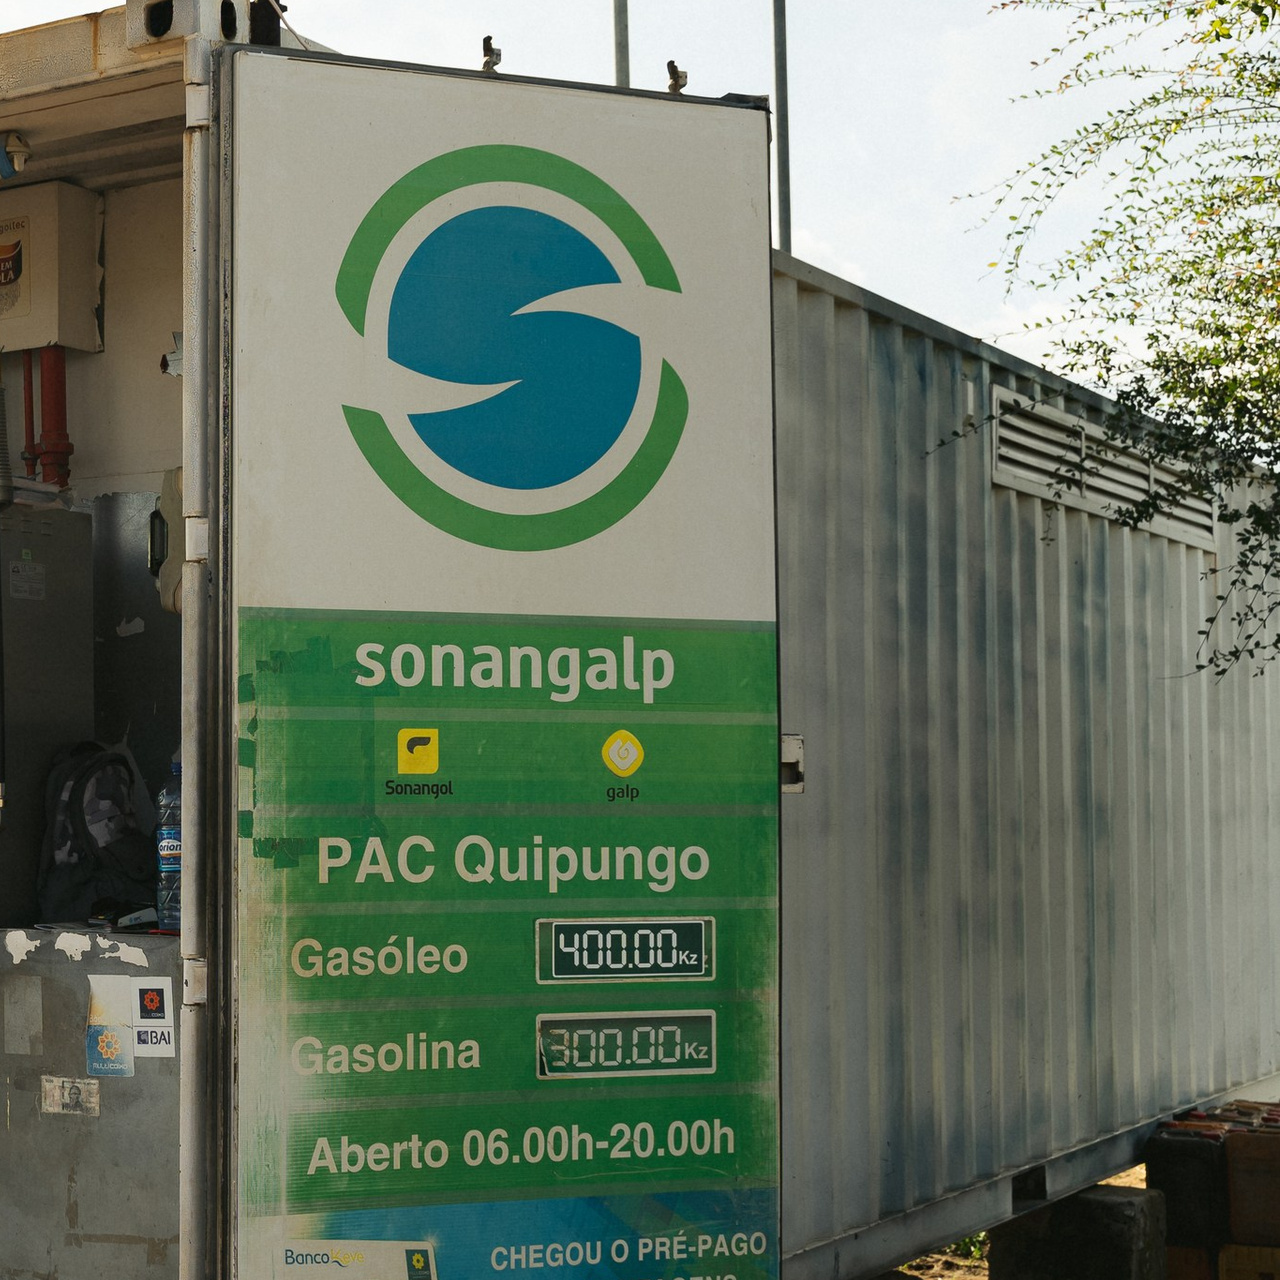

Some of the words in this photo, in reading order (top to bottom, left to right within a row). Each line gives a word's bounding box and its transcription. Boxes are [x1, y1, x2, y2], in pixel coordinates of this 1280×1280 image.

[1, 261, 13, 271] EM
[355, 635, 675, 704] sonangalp
[385, 780, 454, 799] Sonangol
[606, 784, 639, 801] galp
[318, 835, 435, 883] PAC
[455, 835, 710, 893] Quipungo
[291, 935, 468, 978] Gasóleo
[559, 929, 677, 969] 400.00
[679, 951, 698, 964] Kz
[150, 1030, 171, 1045] BAI
[291, 1032, 481, 1076] Gasolina
[549, 1026, 681, 1067] 300.00
[684, 1042, 708, 1059] Kz
[307, 1134, 449, 1176] Aberto
[463, 1118, 735, 1167] 06.00h-20.00h
[491, 1241, 602, 1271] CHEGOU
[611, 1239, 629, 1263] O
[638, 1230, 767, 1261] PRÉ-PAGO
